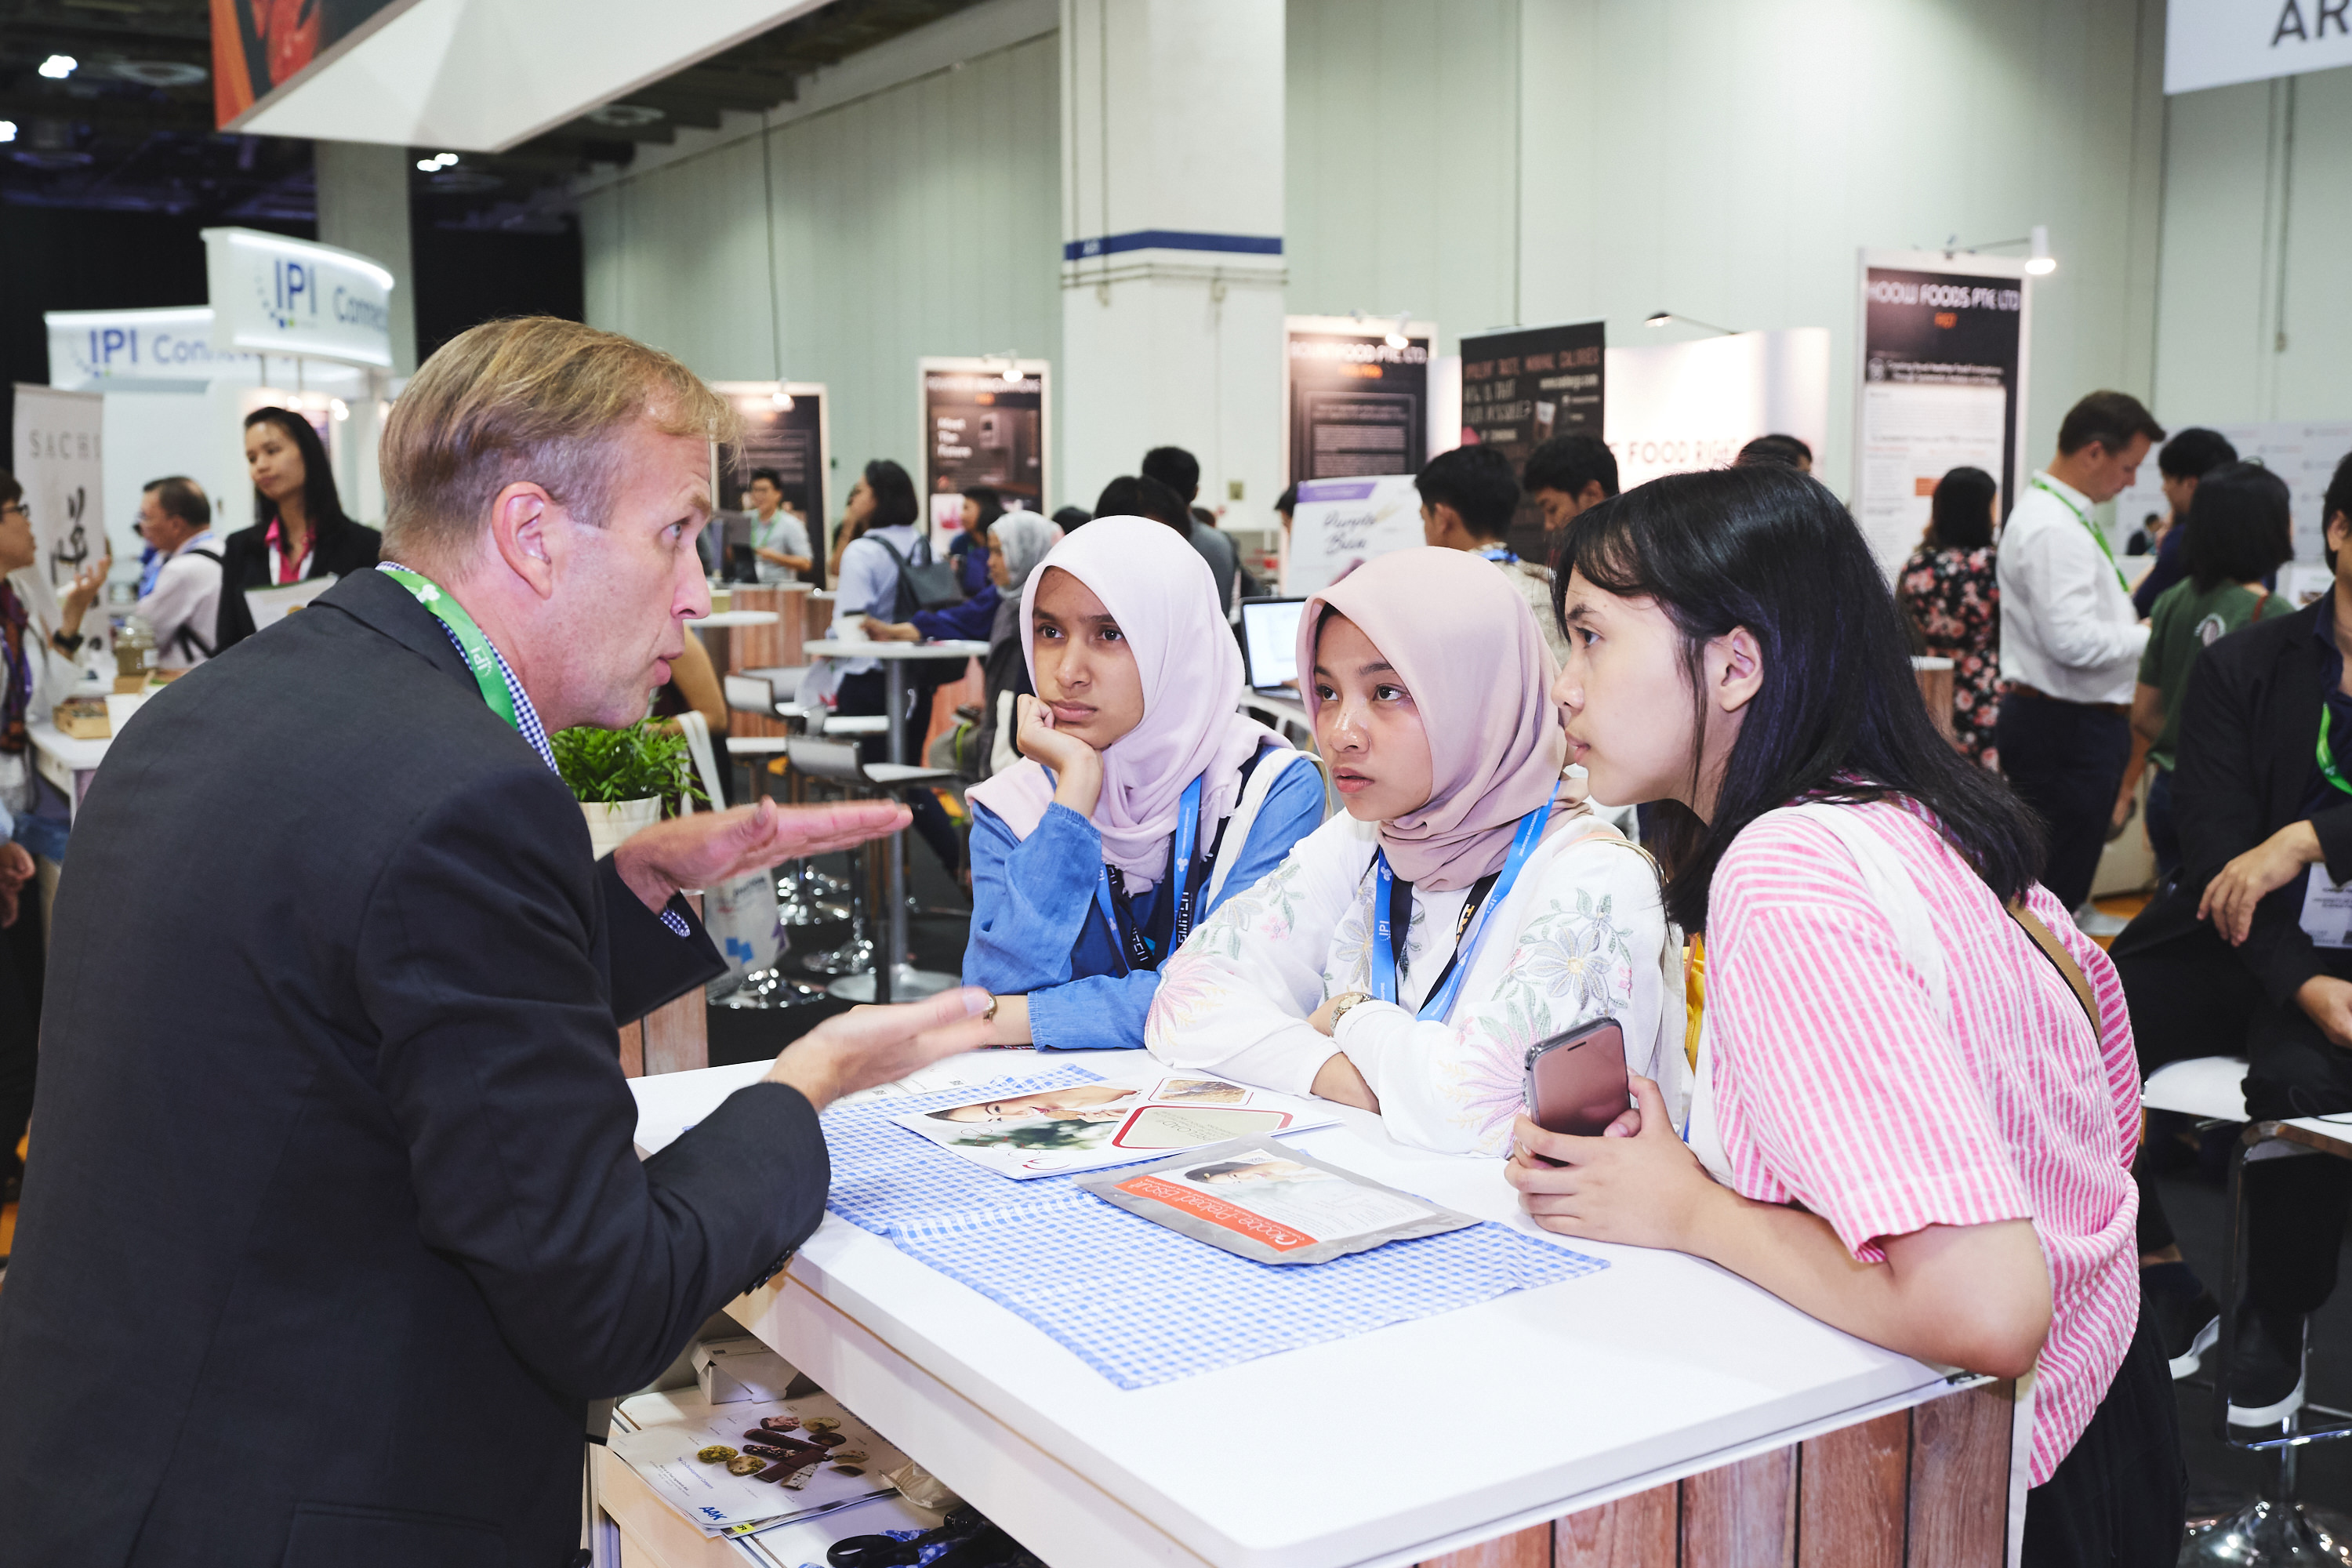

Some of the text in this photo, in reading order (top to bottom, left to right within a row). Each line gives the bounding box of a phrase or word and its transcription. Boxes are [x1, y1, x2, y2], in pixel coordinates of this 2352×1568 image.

[275, 259, 317, 314] IPI
[1920, 284, 1970, 308] FOODS
[90, 329, 136, 363] IPI
[470, 646, 489, 671] IPI
[1379, 920, 1390, 936] IPI
[699, 1506, 728, 1521] AAK
